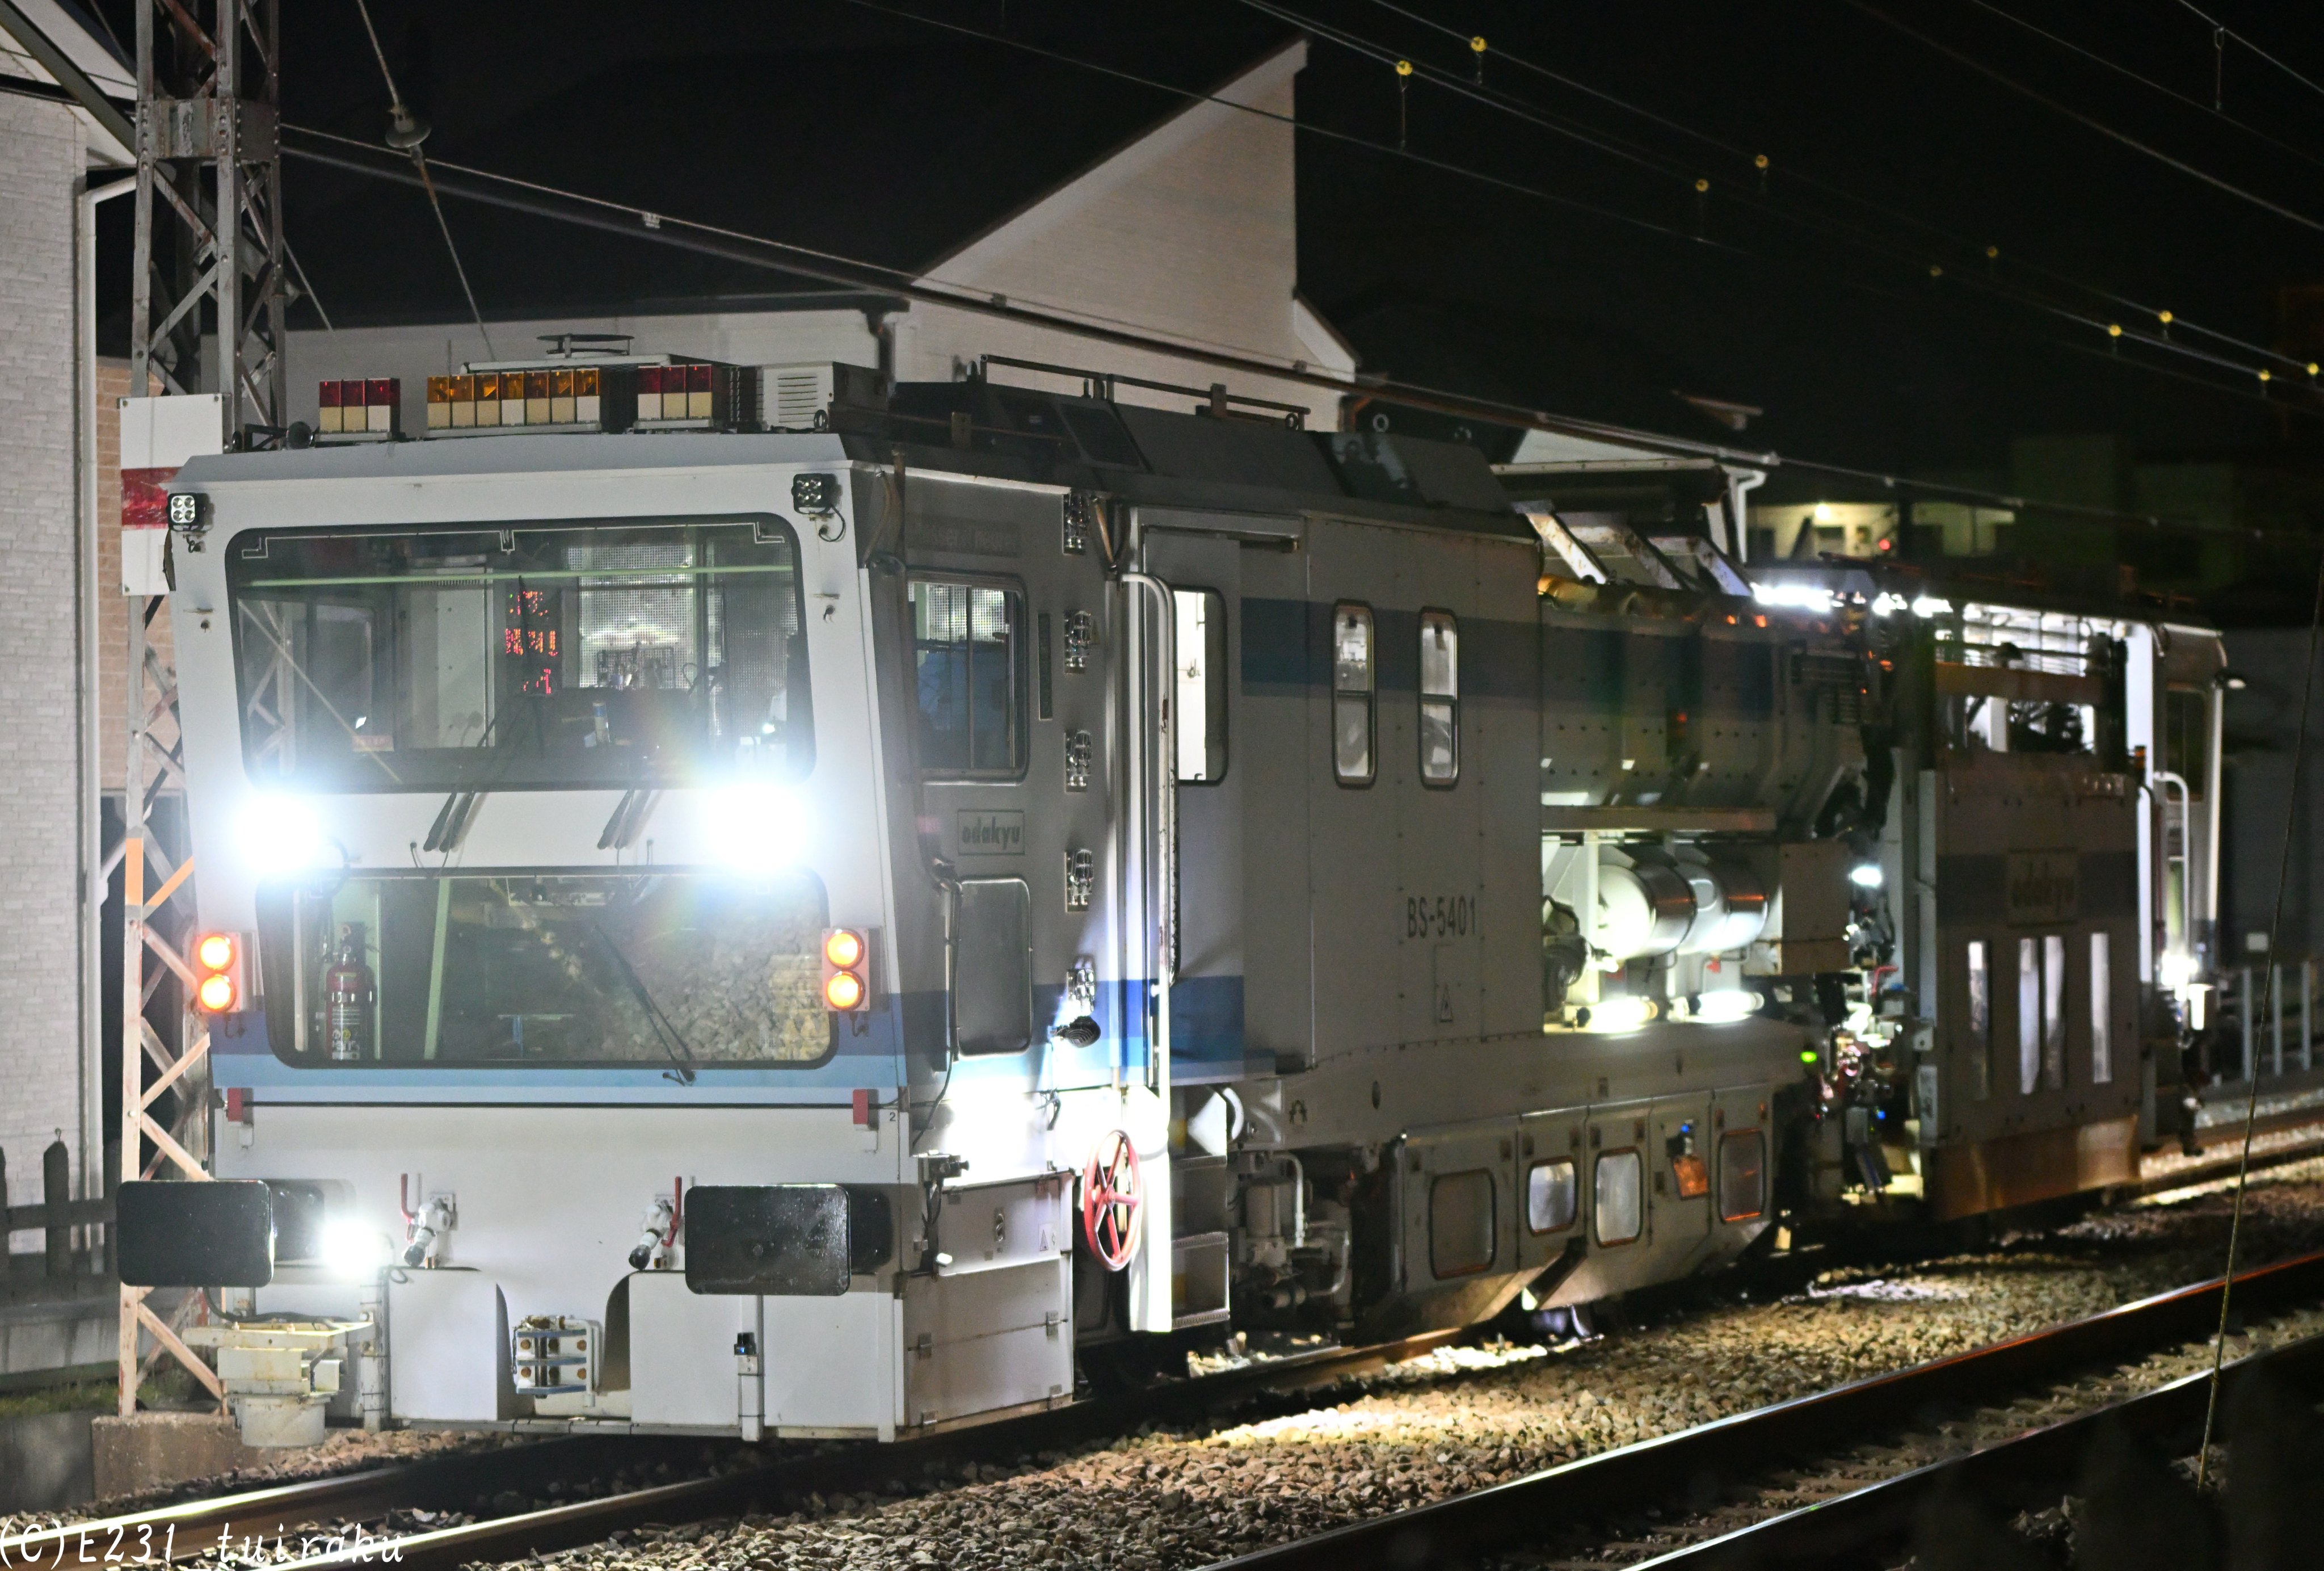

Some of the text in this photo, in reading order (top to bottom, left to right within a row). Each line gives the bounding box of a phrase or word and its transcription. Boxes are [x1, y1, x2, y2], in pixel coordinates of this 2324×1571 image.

[962, 816, 1020, 850] odakyu
[1408, 895, 1475, 938] BS-5401
[889, 1111, 896, 1122] 2
